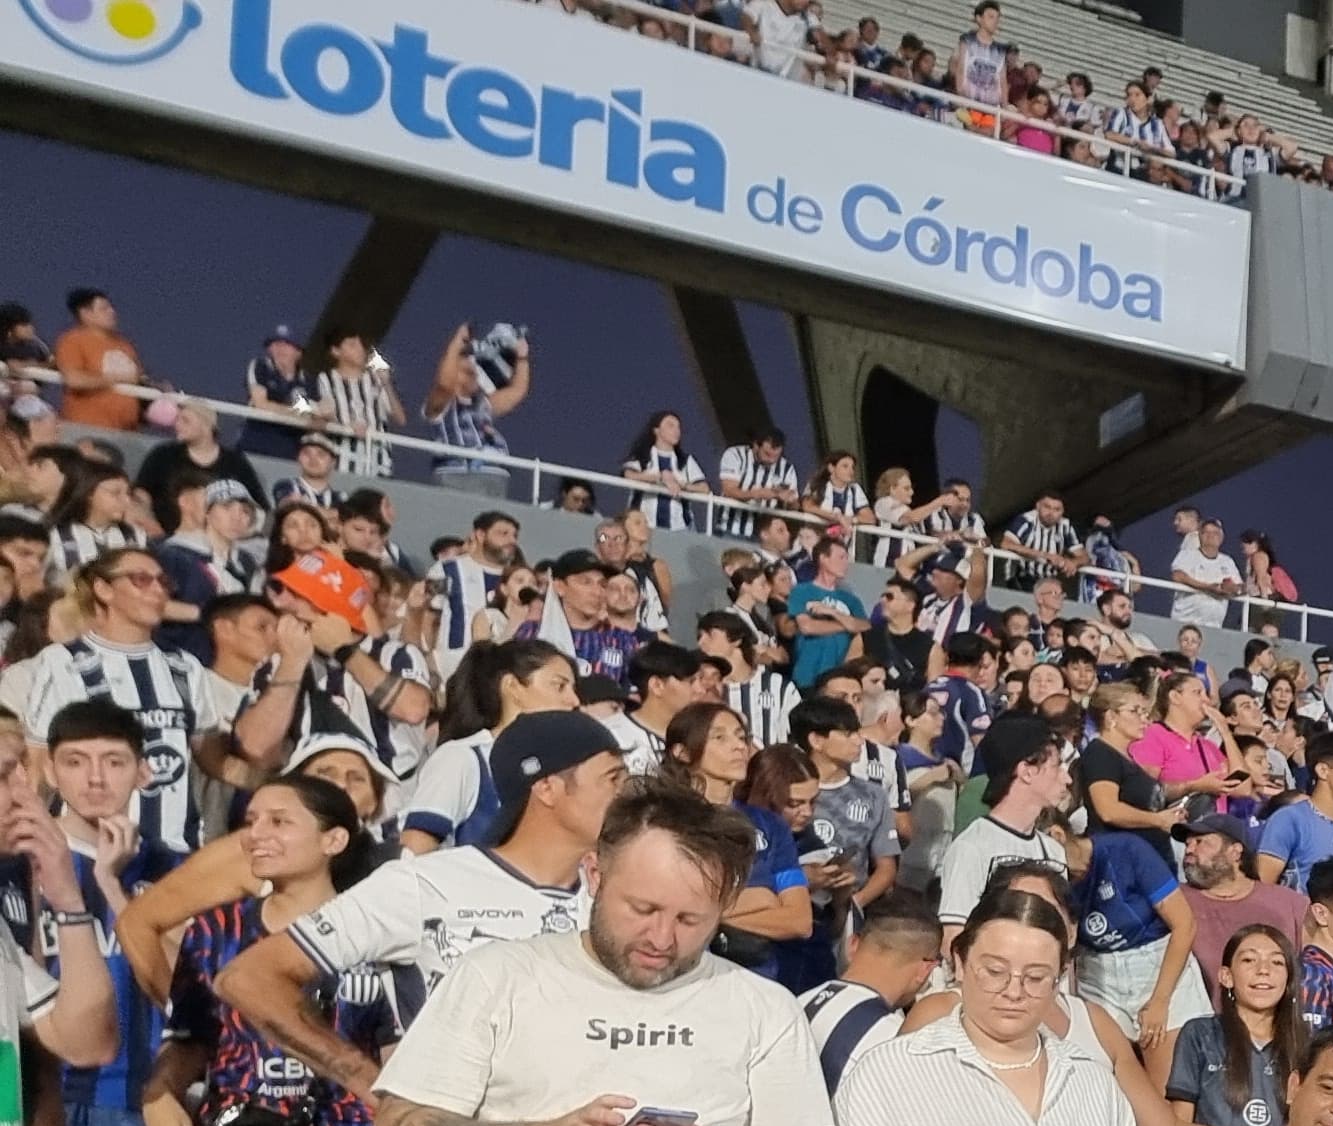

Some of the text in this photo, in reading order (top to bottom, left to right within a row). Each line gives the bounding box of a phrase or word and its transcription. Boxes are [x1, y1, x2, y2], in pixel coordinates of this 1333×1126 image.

[747, 178, 822, 235] de
[841, 184, 1163, 323] Córdoba
[457, 909, 524, 919] GIVOVA
[586, 1018, 695, 1050] Spirit
[257, 1057, 314, 1081] ICB
